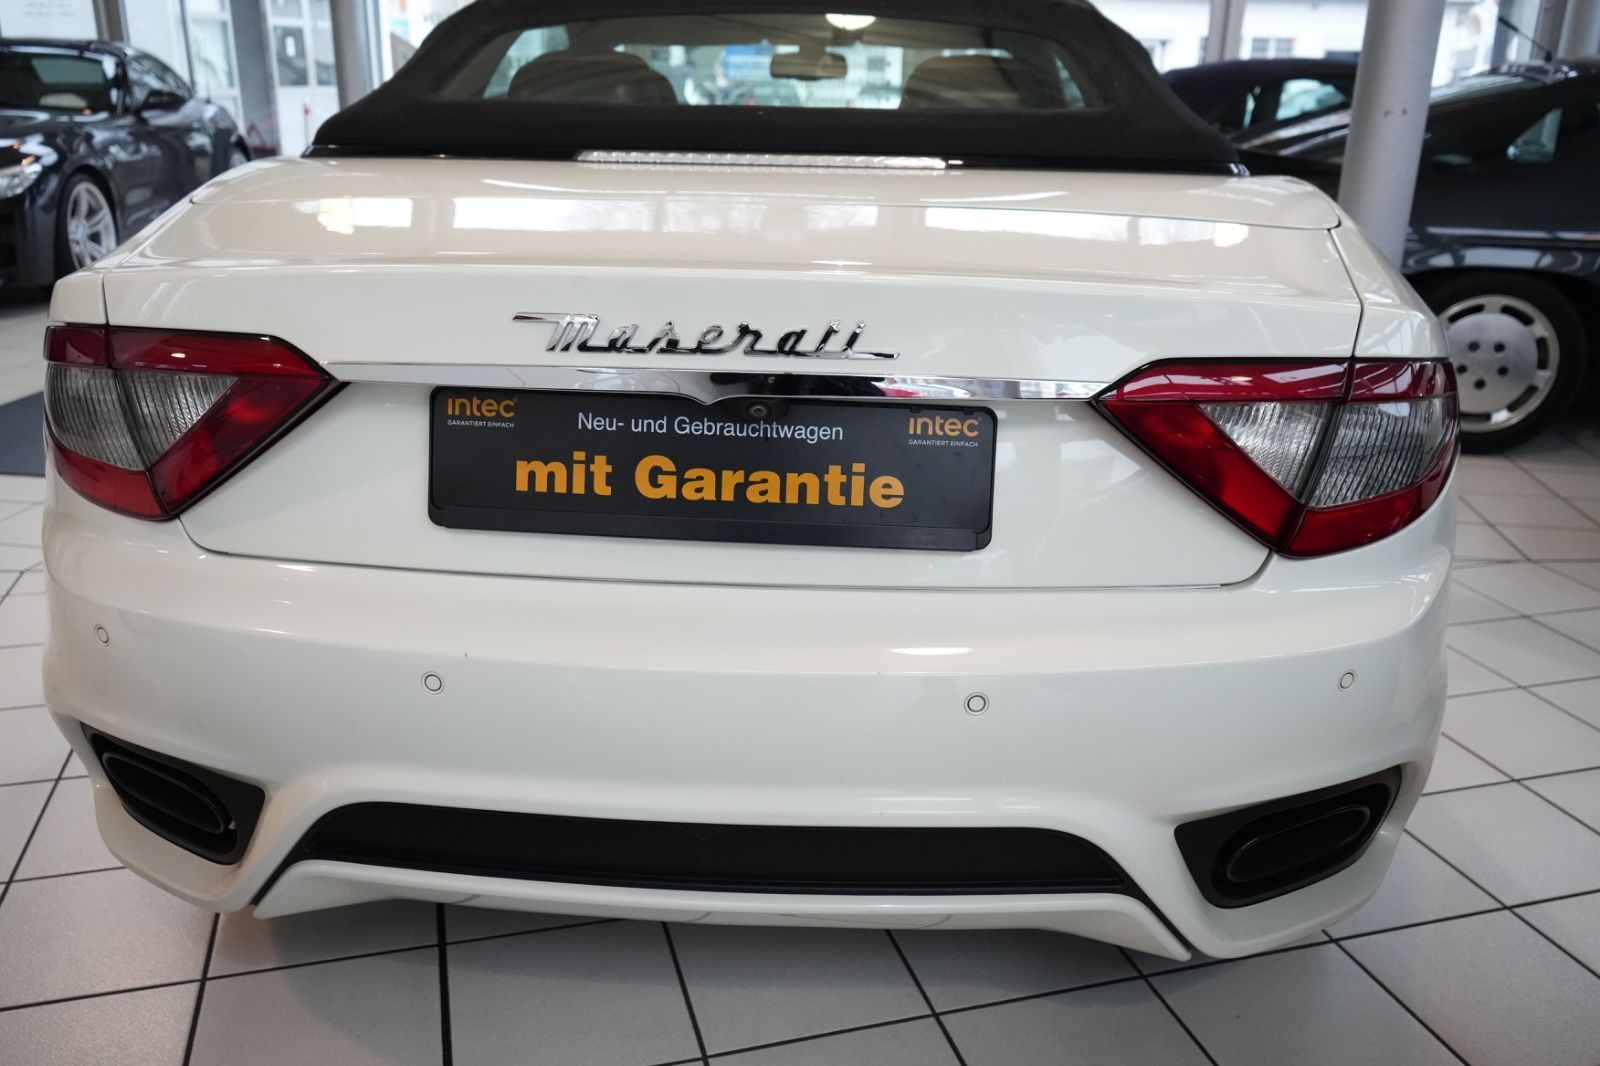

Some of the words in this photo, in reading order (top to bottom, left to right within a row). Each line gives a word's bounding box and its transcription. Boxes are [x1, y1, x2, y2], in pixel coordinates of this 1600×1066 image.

[512, 311, 901, 361] Maserati
[447, 419, 487, 427] GARANTIERT
[577, 412, 624, 432] Neu-
[631, 416, 667, 434] und
[674, 416, 844, 445] Gebrauchtwagen
[514, 451, 612, 495] mit
[634, 456, 905, 509] Garantie
